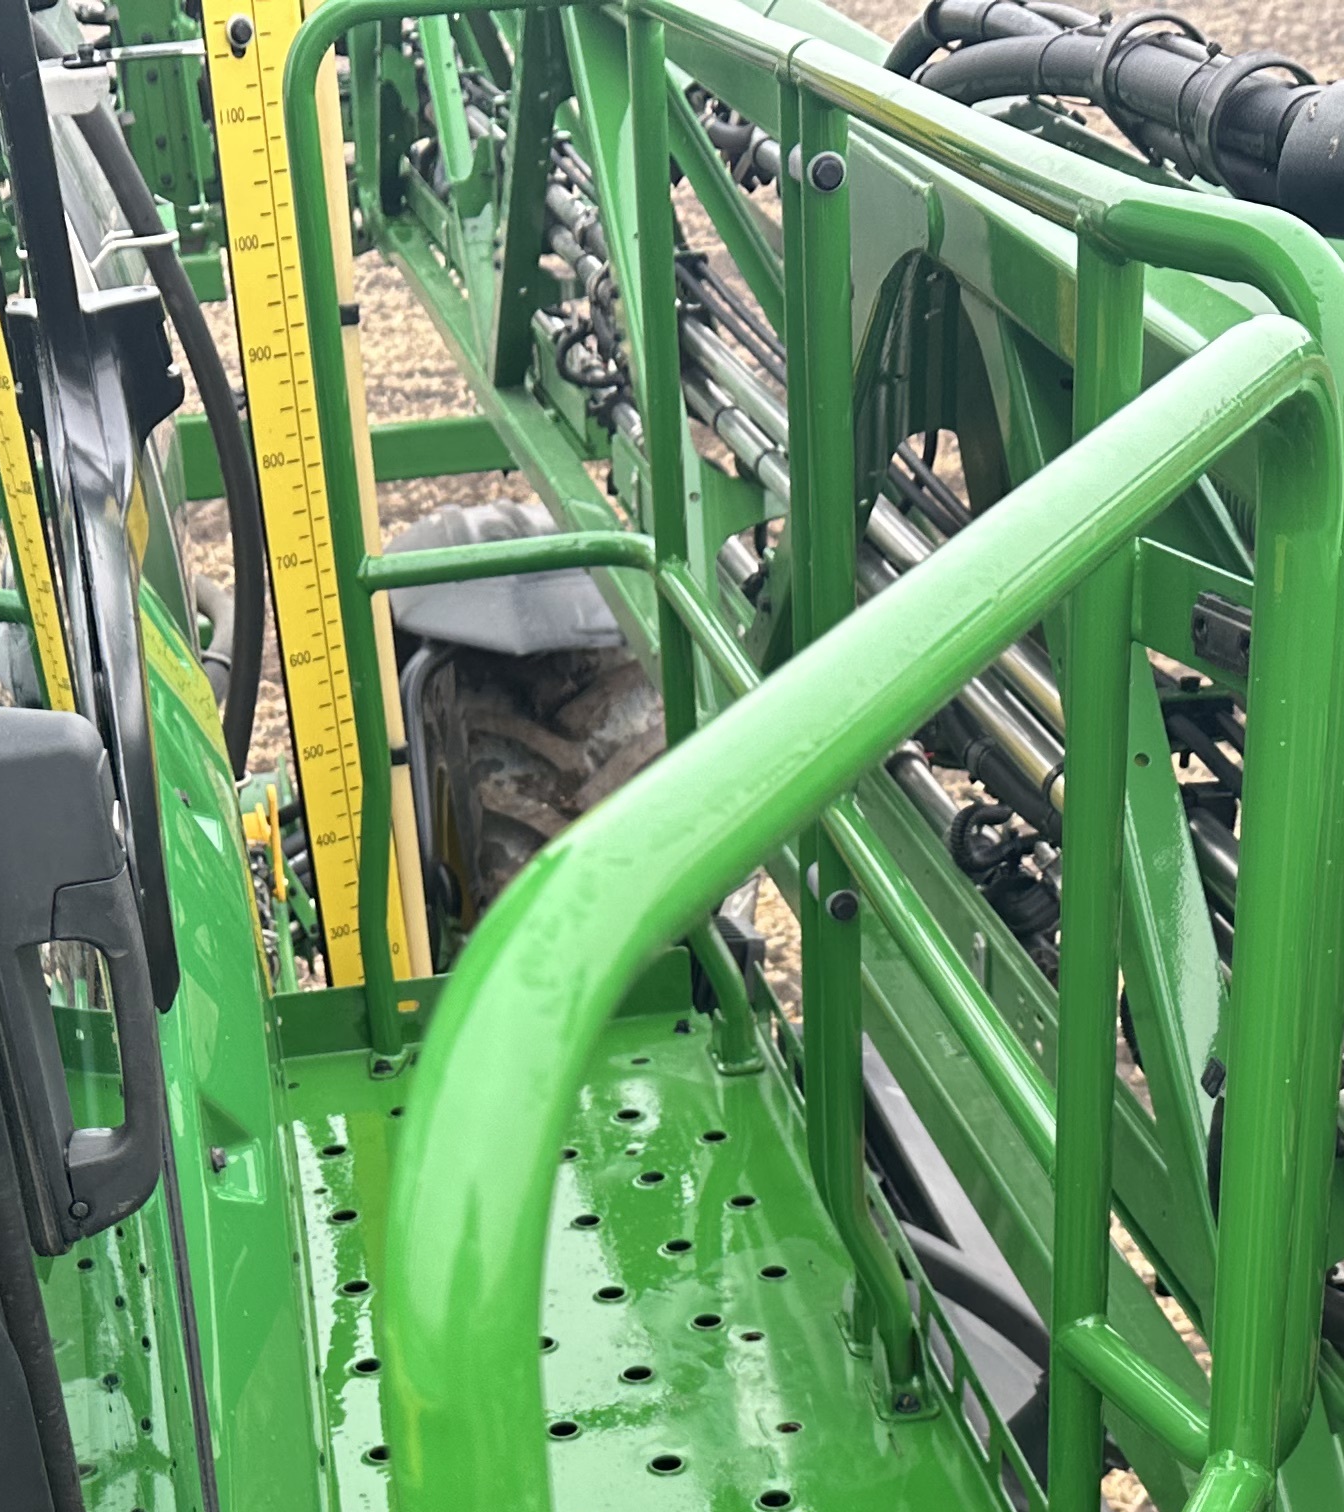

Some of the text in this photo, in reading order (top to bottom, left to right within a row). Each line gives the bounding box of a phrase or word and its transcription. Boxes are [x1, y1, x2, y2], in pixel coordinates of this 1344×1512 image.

[219, 106, 245, 125] 1100
[234, 234, 259, 251] 1000
[248, 345, 272, 363] 900
[262, 451, 285, 469] 800
[276, 552, 298, 570] 700
[289, 650, 312, 668] 600
[303, 744, 324, 762] 500
[316, 831, 337, 848] 400
[330, 923, 351, 940] 300
